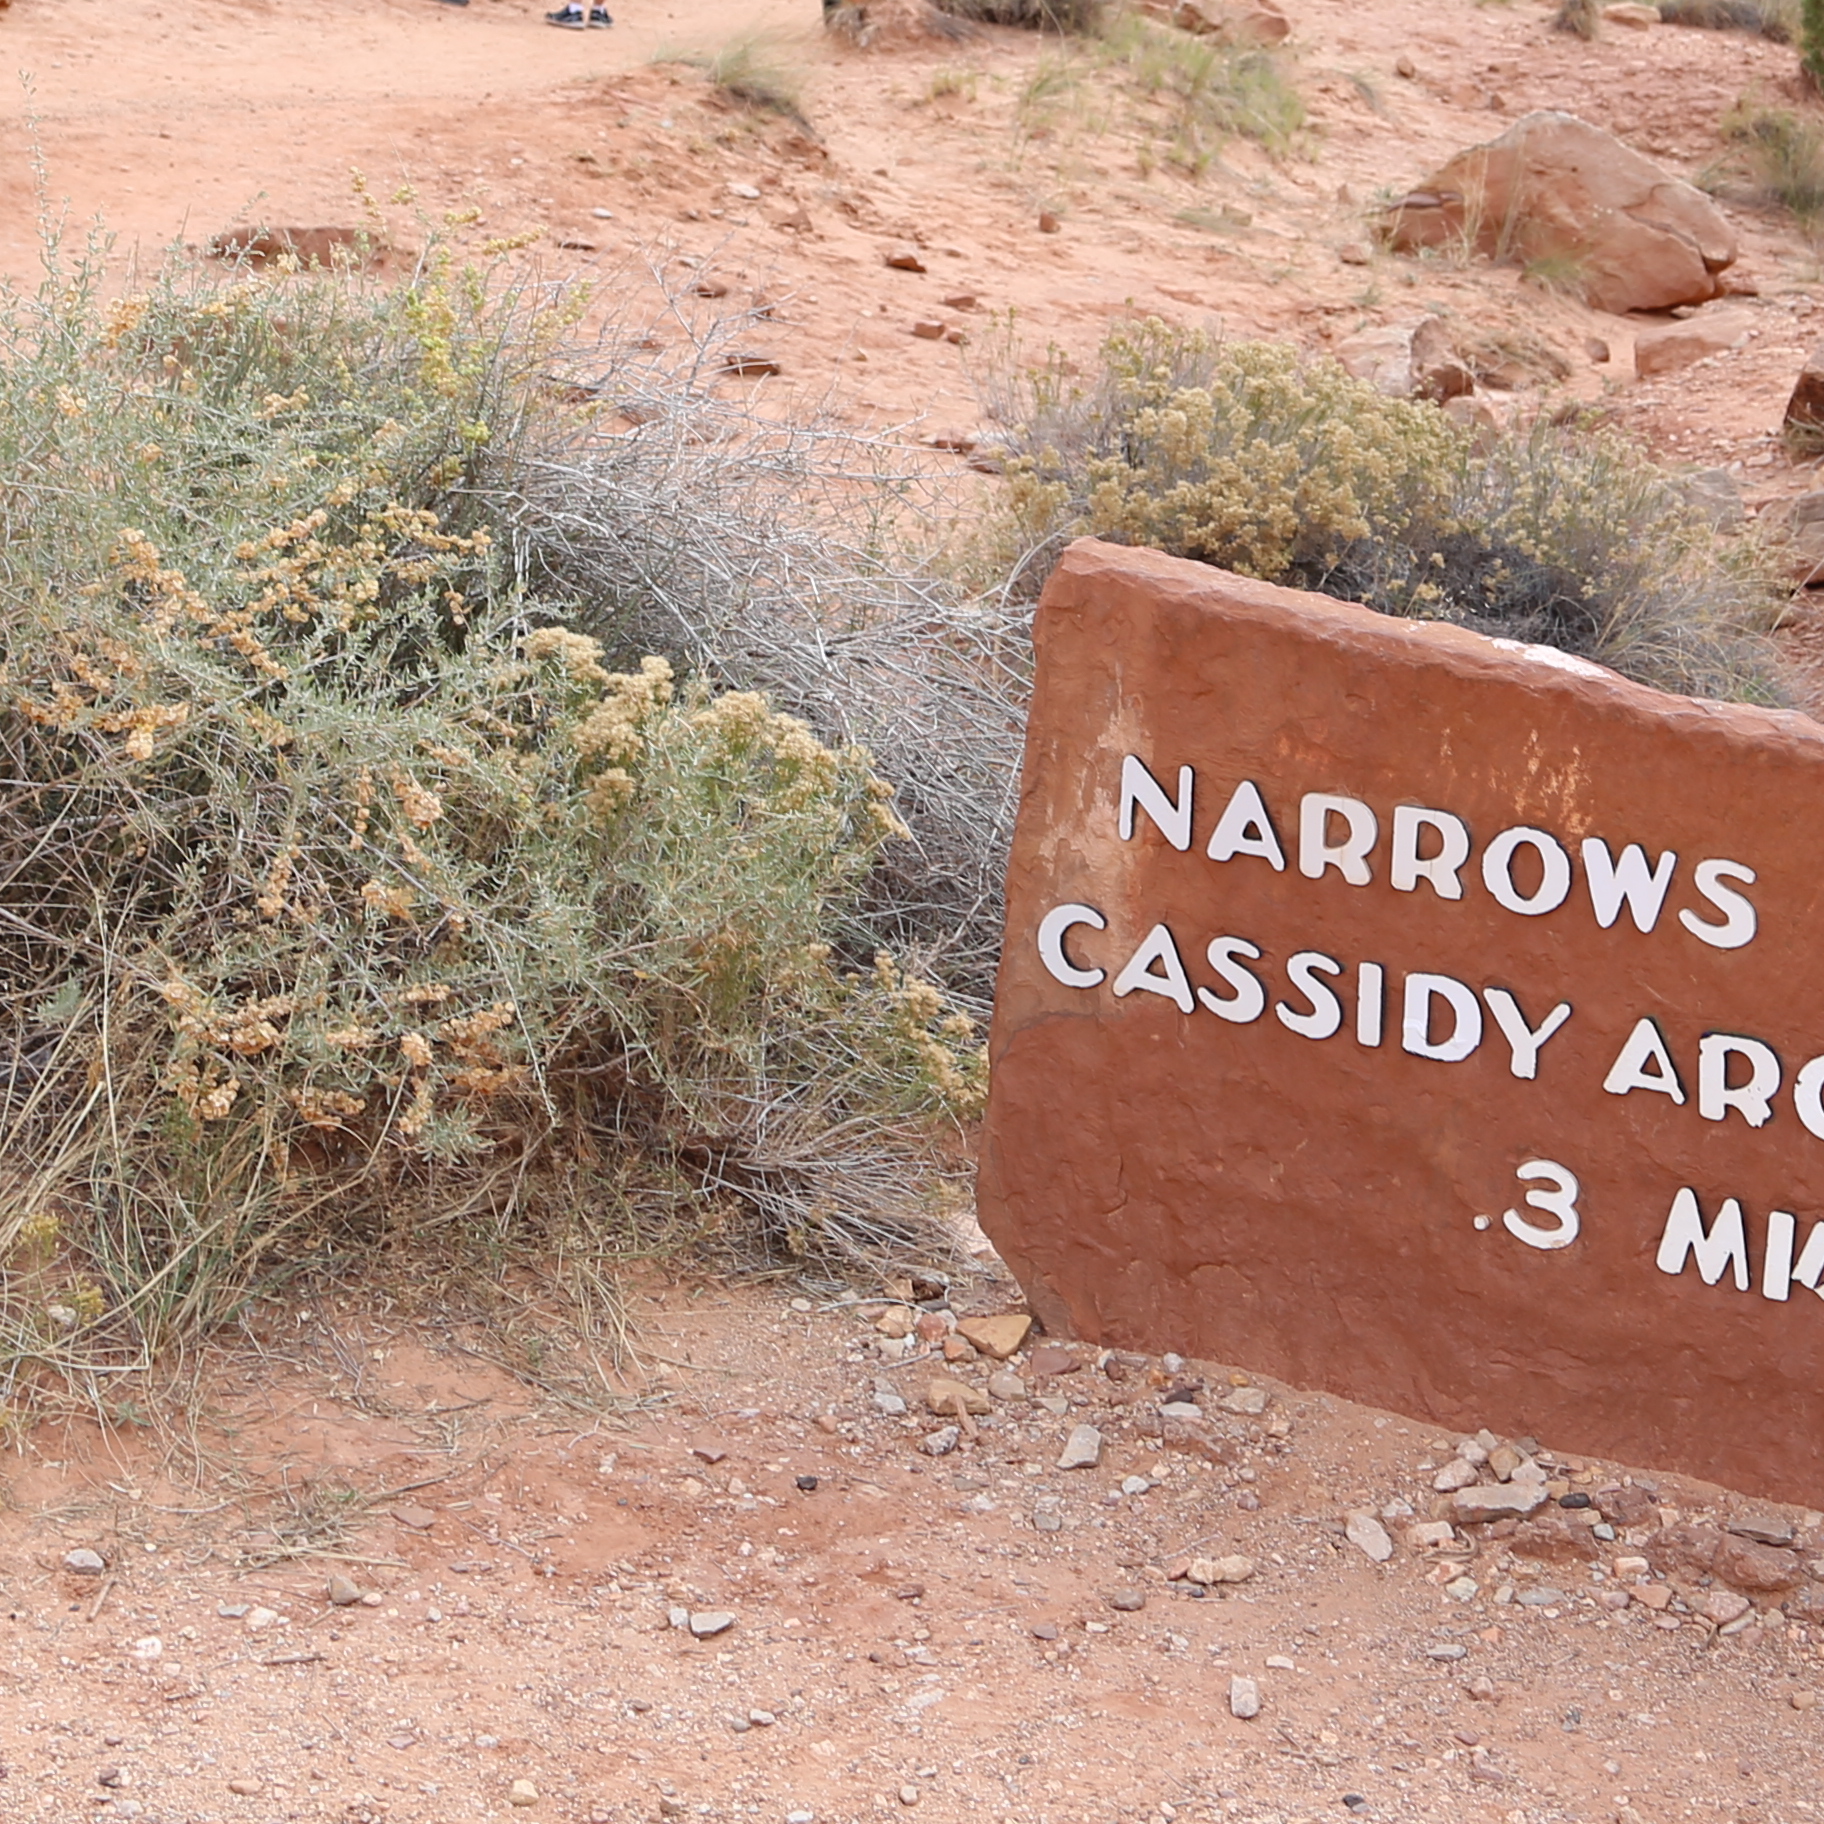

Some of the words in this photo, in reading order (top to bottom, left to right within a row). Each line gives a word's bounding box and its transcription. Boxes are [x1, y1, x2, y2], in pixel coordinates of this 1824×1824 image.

[1117, 753, 1758, 950] NARROWS
[1036, 902, 1572, 1082] CASSIDY
[1472, 1158, 1581, 1251] .3
